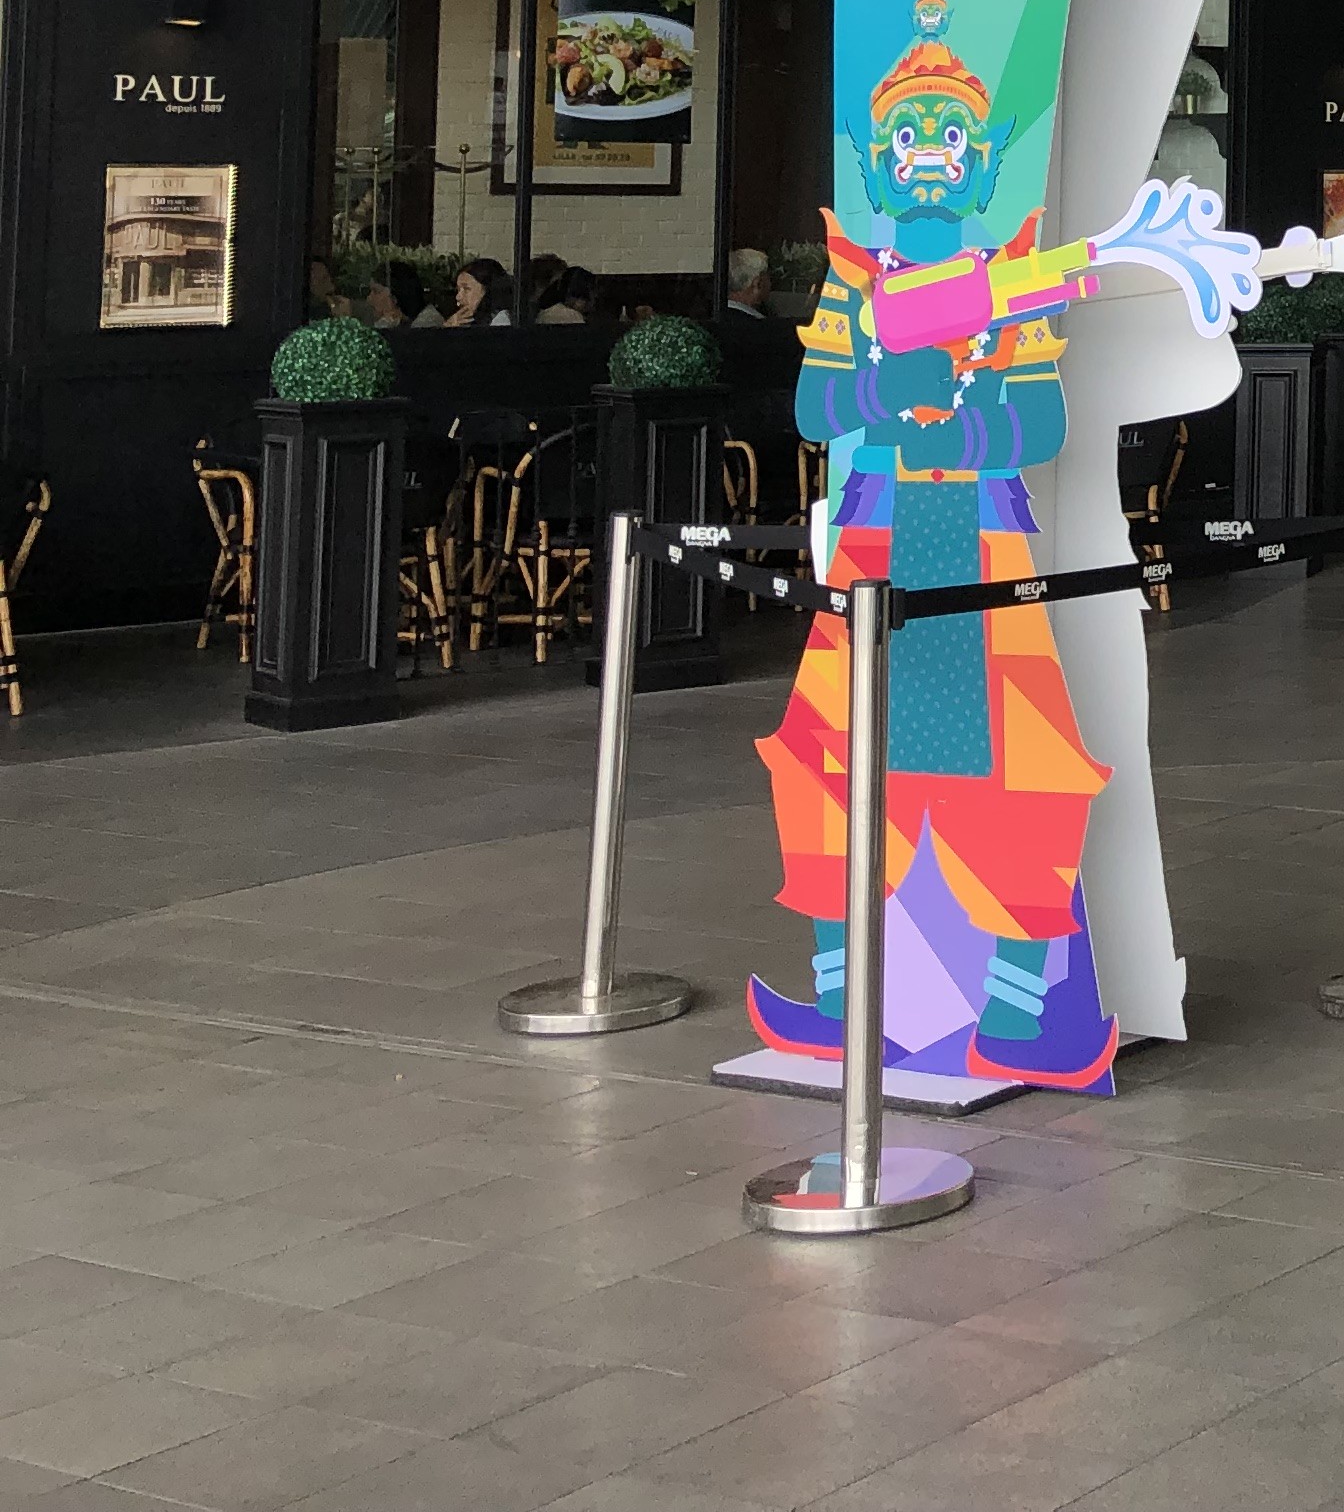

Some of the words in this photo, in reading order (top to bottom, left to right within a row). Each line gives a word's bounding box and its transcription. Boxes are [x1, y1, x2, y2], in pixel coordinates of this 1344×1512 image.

[114, 74, 226, 102] PAUL
[681, 525, 731, 547] MEGA
[1204, 521, 1254, 540] MEGA
[1258, 543, 1286, 561] MEGA
[1143, 562, 1173, 580] MEGA
[1015, 580, 1048, 599] MEGA
